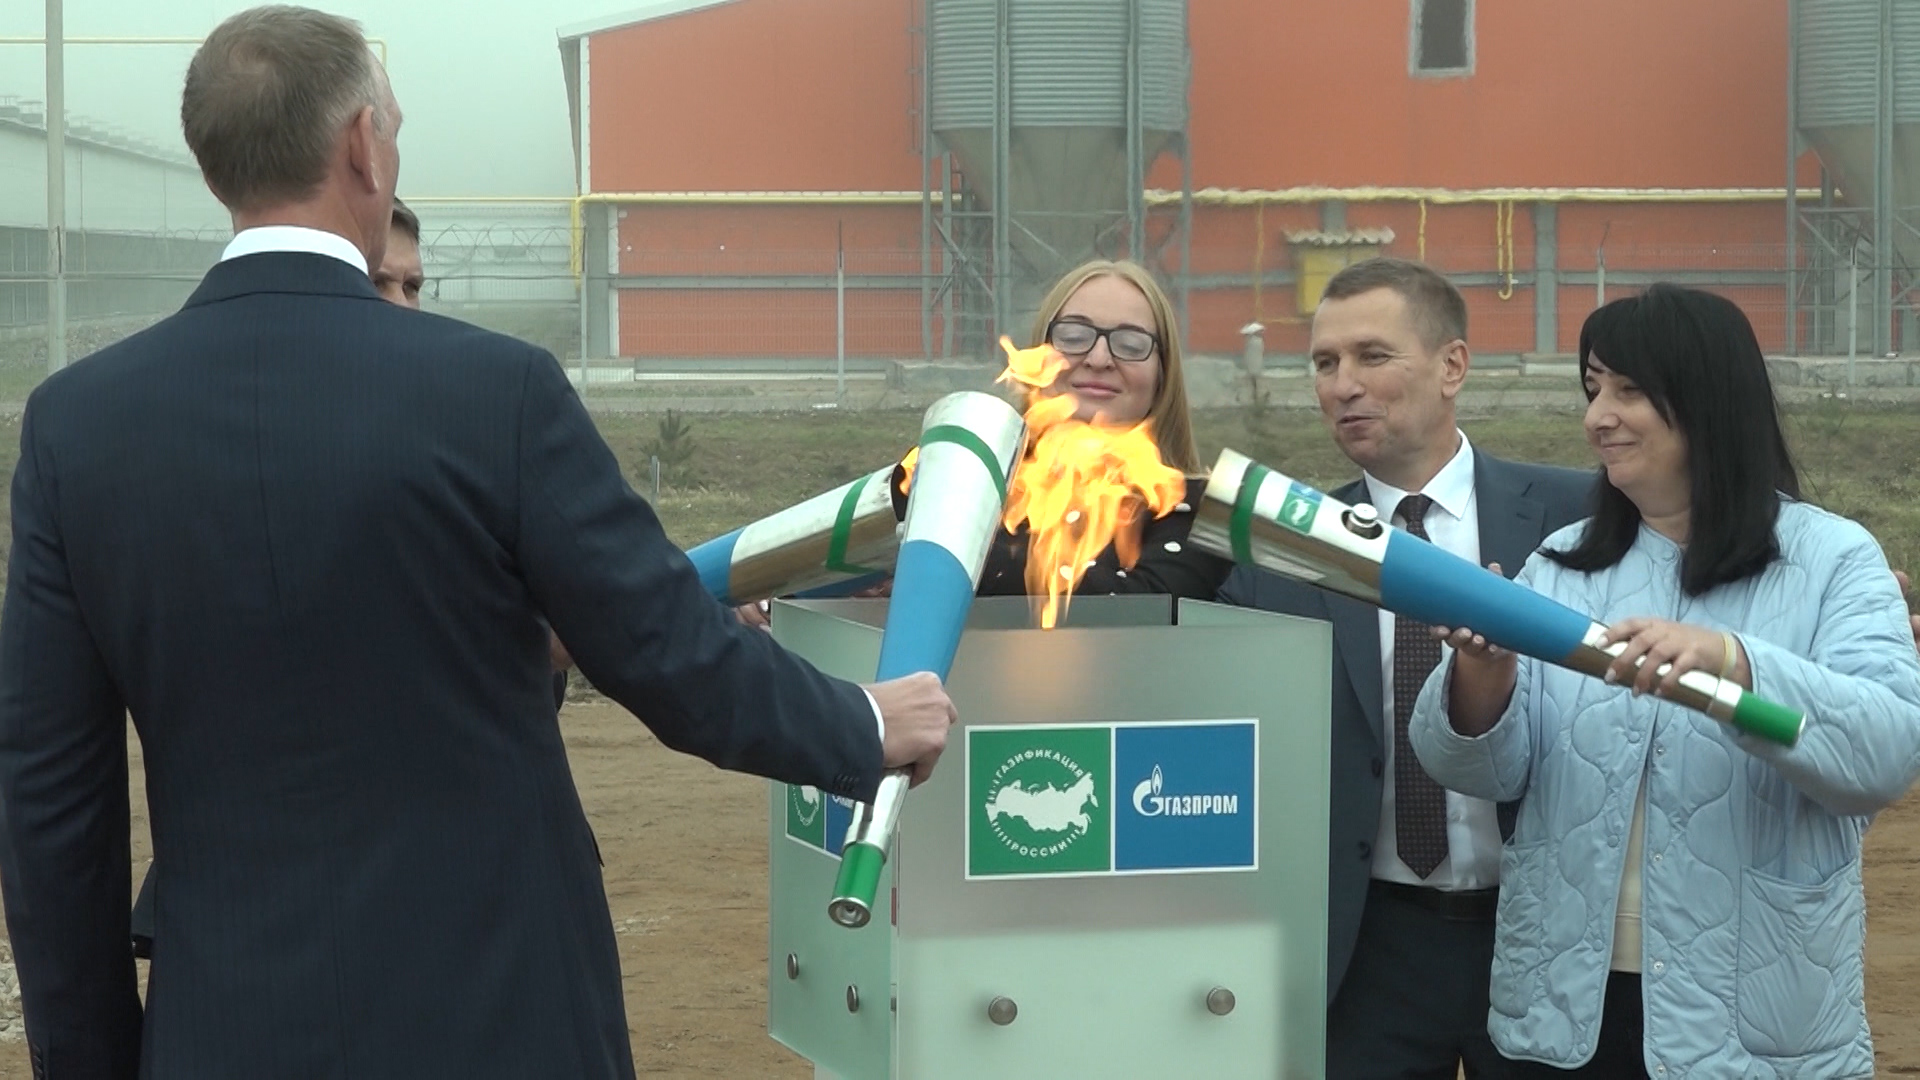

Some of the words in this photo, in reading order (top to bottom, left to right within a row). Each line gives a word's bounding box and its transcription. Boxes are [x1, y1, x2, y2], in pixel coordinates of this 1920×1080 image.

[996, 748, 1084, 778] ГАЗИФИКАЦИЯ
[1164, 795, 1238, 816] ГАЗПРОМ
[1010, 840, 1069, 858] РОССИИ
